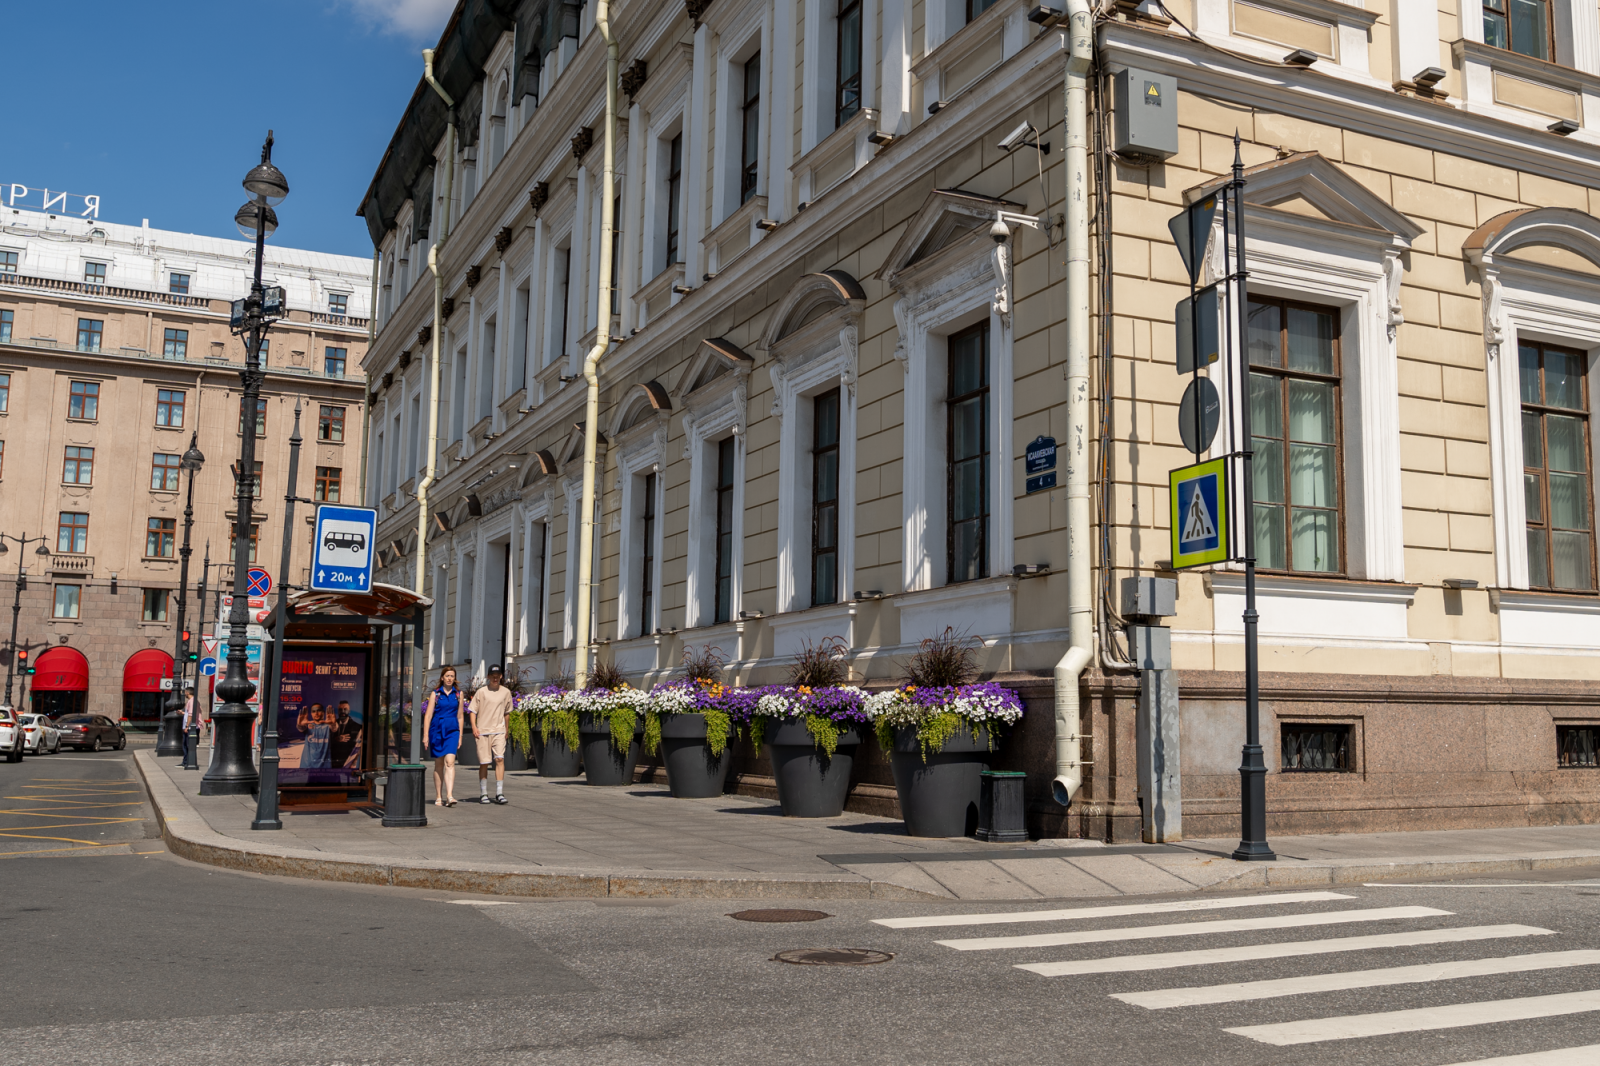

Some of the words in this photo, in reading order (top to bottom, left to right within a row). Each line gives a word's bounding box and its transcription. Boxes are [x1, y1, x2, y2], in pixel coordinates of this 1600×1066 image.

[9, 183, 100, 219] РИЯ
[282, 660, 314, 674] BURITO
[338, 666, 358, 676] РОСТОВ
